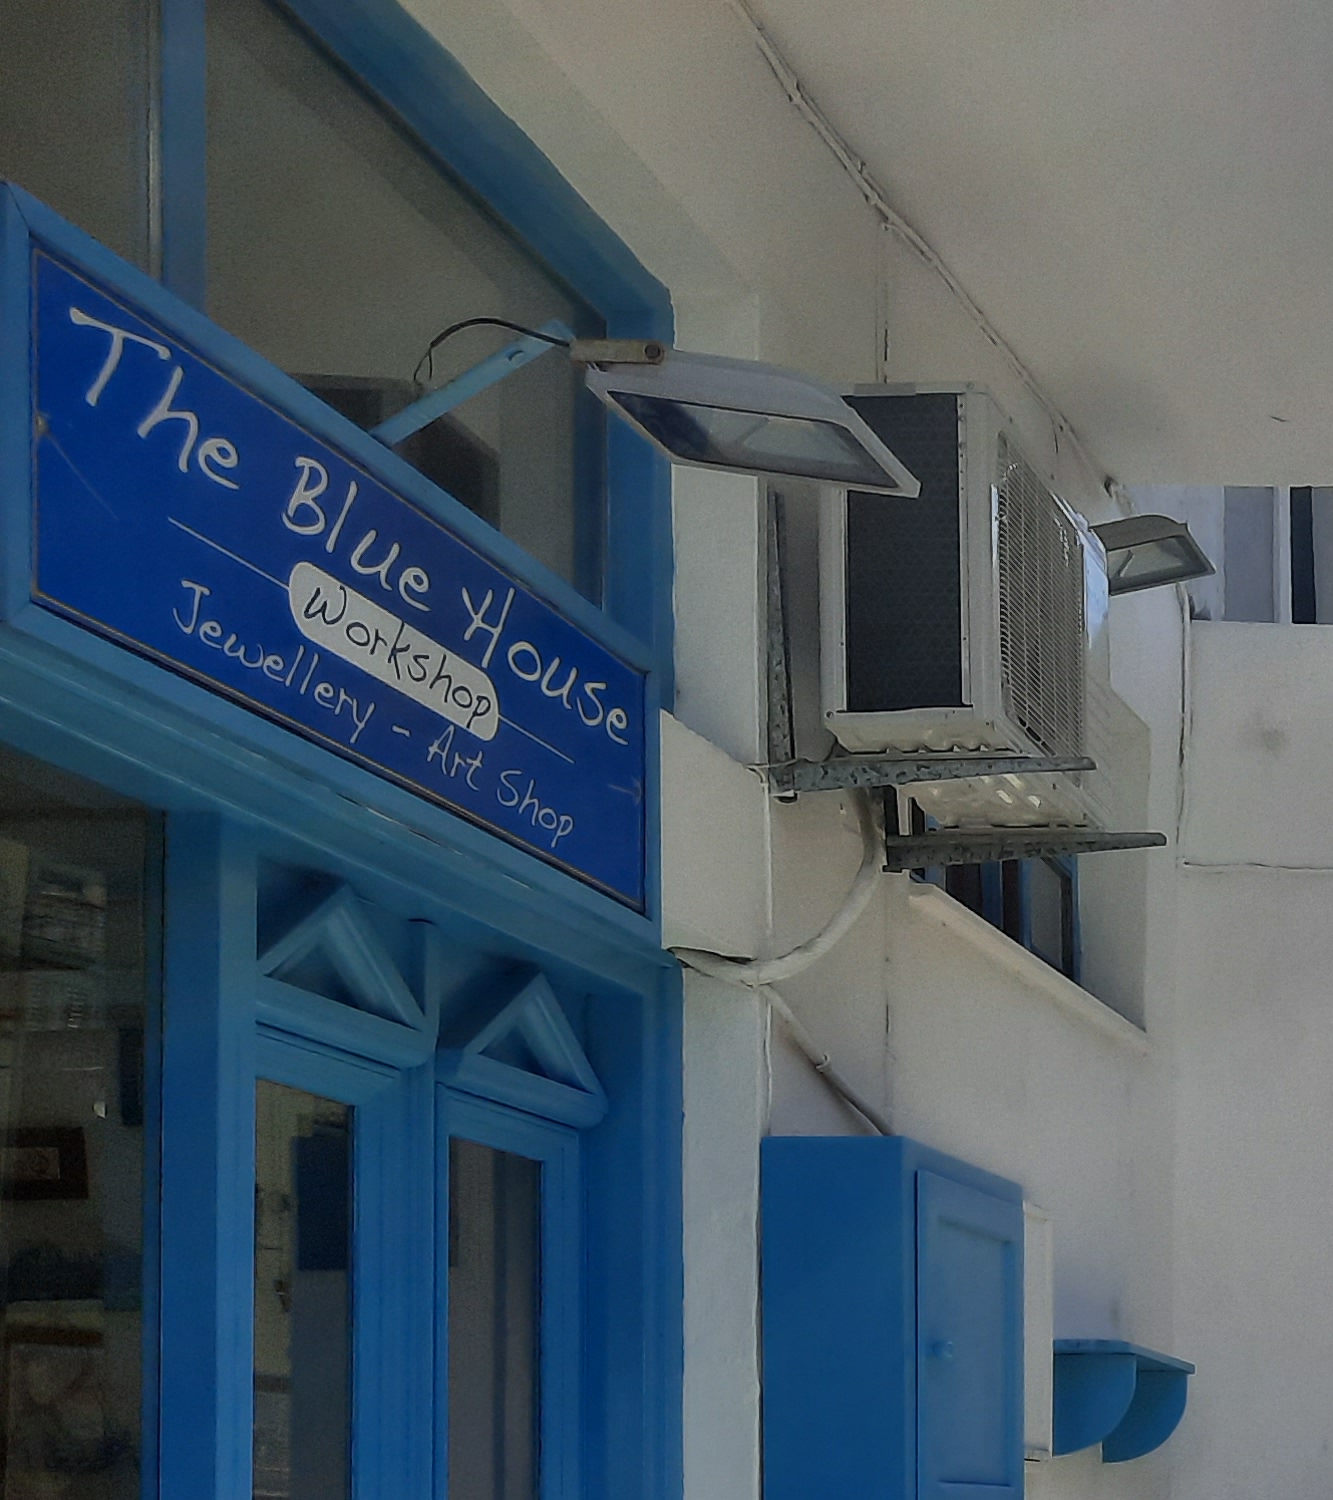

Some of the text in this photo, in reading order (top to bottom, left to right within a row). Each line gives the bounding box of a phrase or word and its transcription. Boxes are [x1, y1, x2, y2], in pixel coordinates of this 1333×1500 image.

[69, 307, 629, 745] The Blue House
[303, 585, 491, 729] Workshop
[173, 579, 375, 743] Jewellery
[427, 725, 485, 791] Art
[496, 769, 575, 848] Shop
